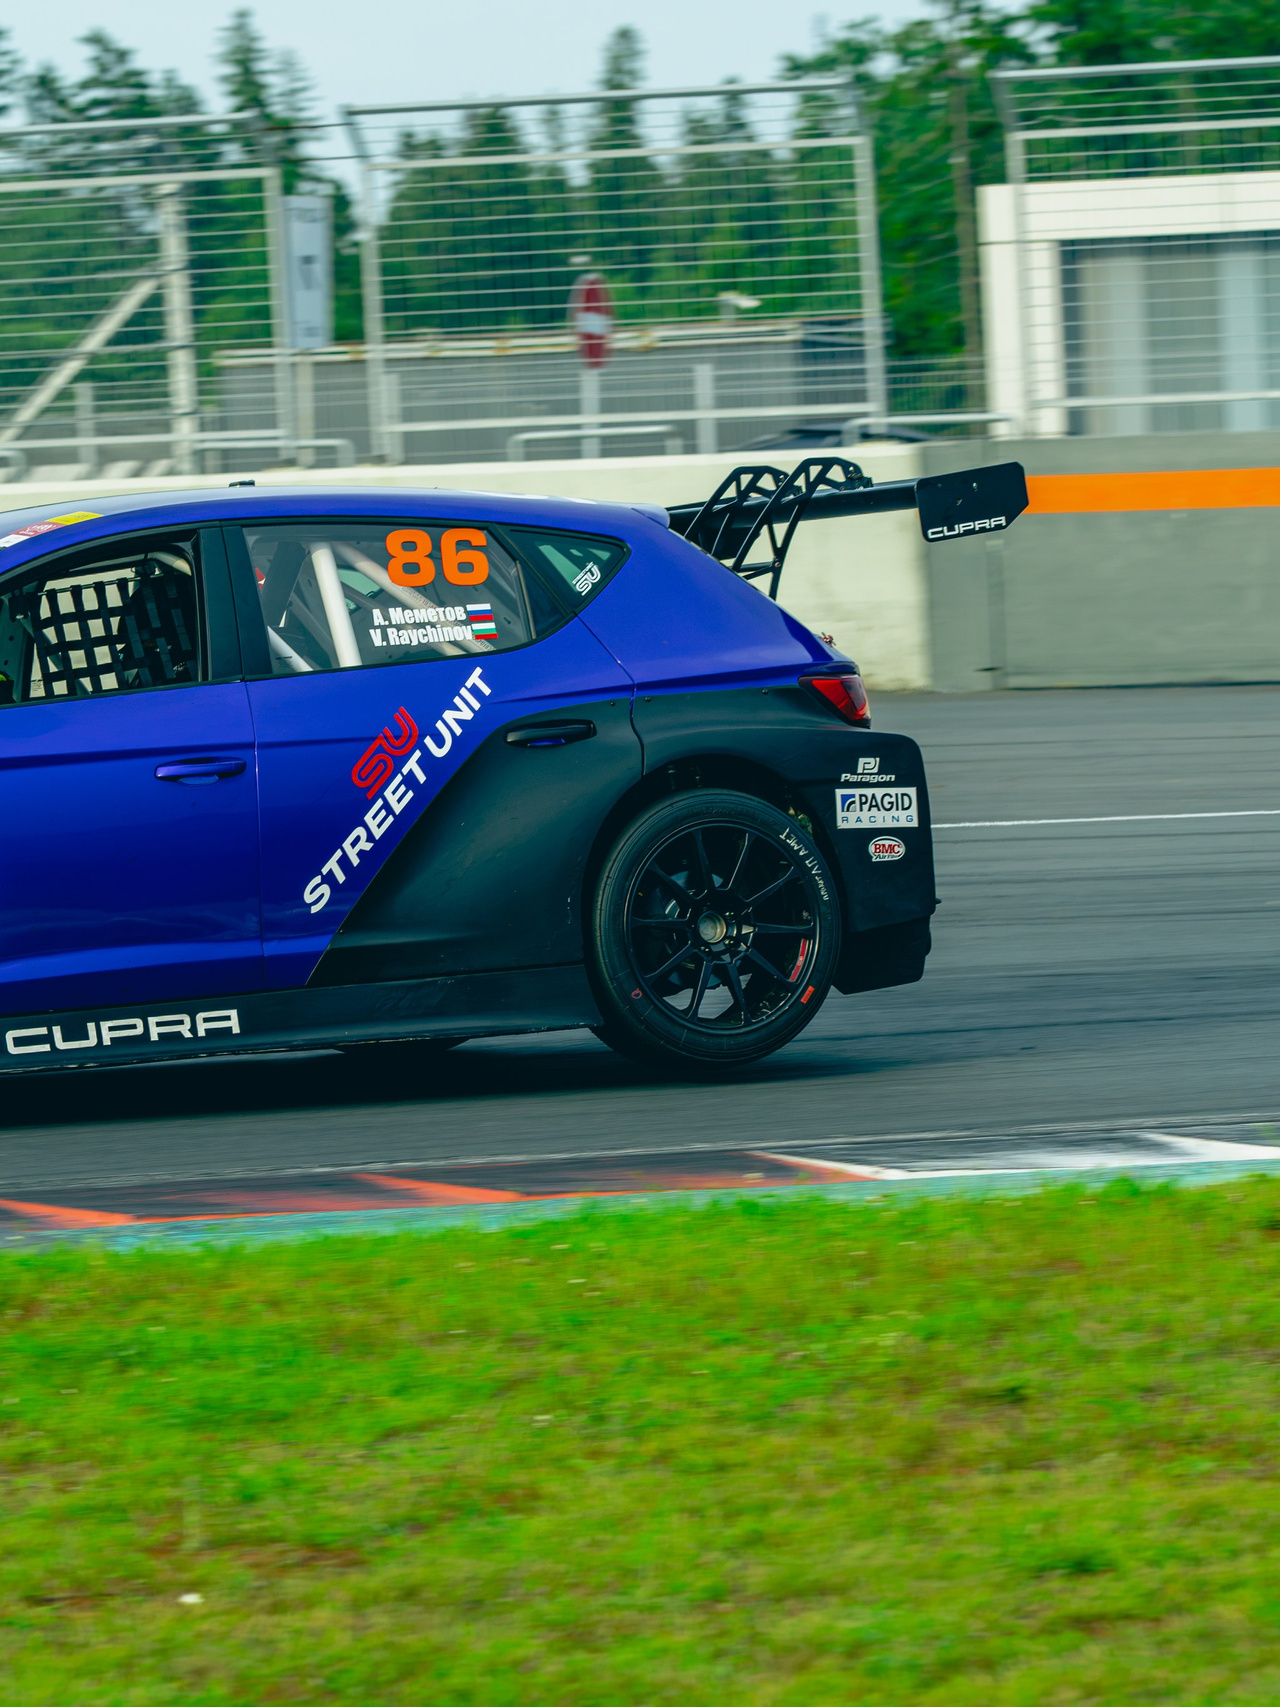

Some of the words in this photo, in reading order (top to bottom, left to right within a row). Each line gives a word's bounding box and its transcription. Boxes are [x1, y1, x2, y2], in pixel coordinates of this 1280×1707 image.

[927, 516, 1007, 539] CUPRA
[385, 528, 489, 587] 86
[369, 628, 387, 647] V.
[387, 625, 474, 646] Raychinov
[351, 706, 419, 800] SU
[840, 773, 896, 783] Paragon
[303, 749, 427, 914] STREET
[423, 666, 492, 758] UNIT
[858, 793, 913, 812] PAGID
[841, 815, 914, 824] RACING
[874, 843, 901, 855] BMC
[5, 1008, 241, 1055] CUPRA
